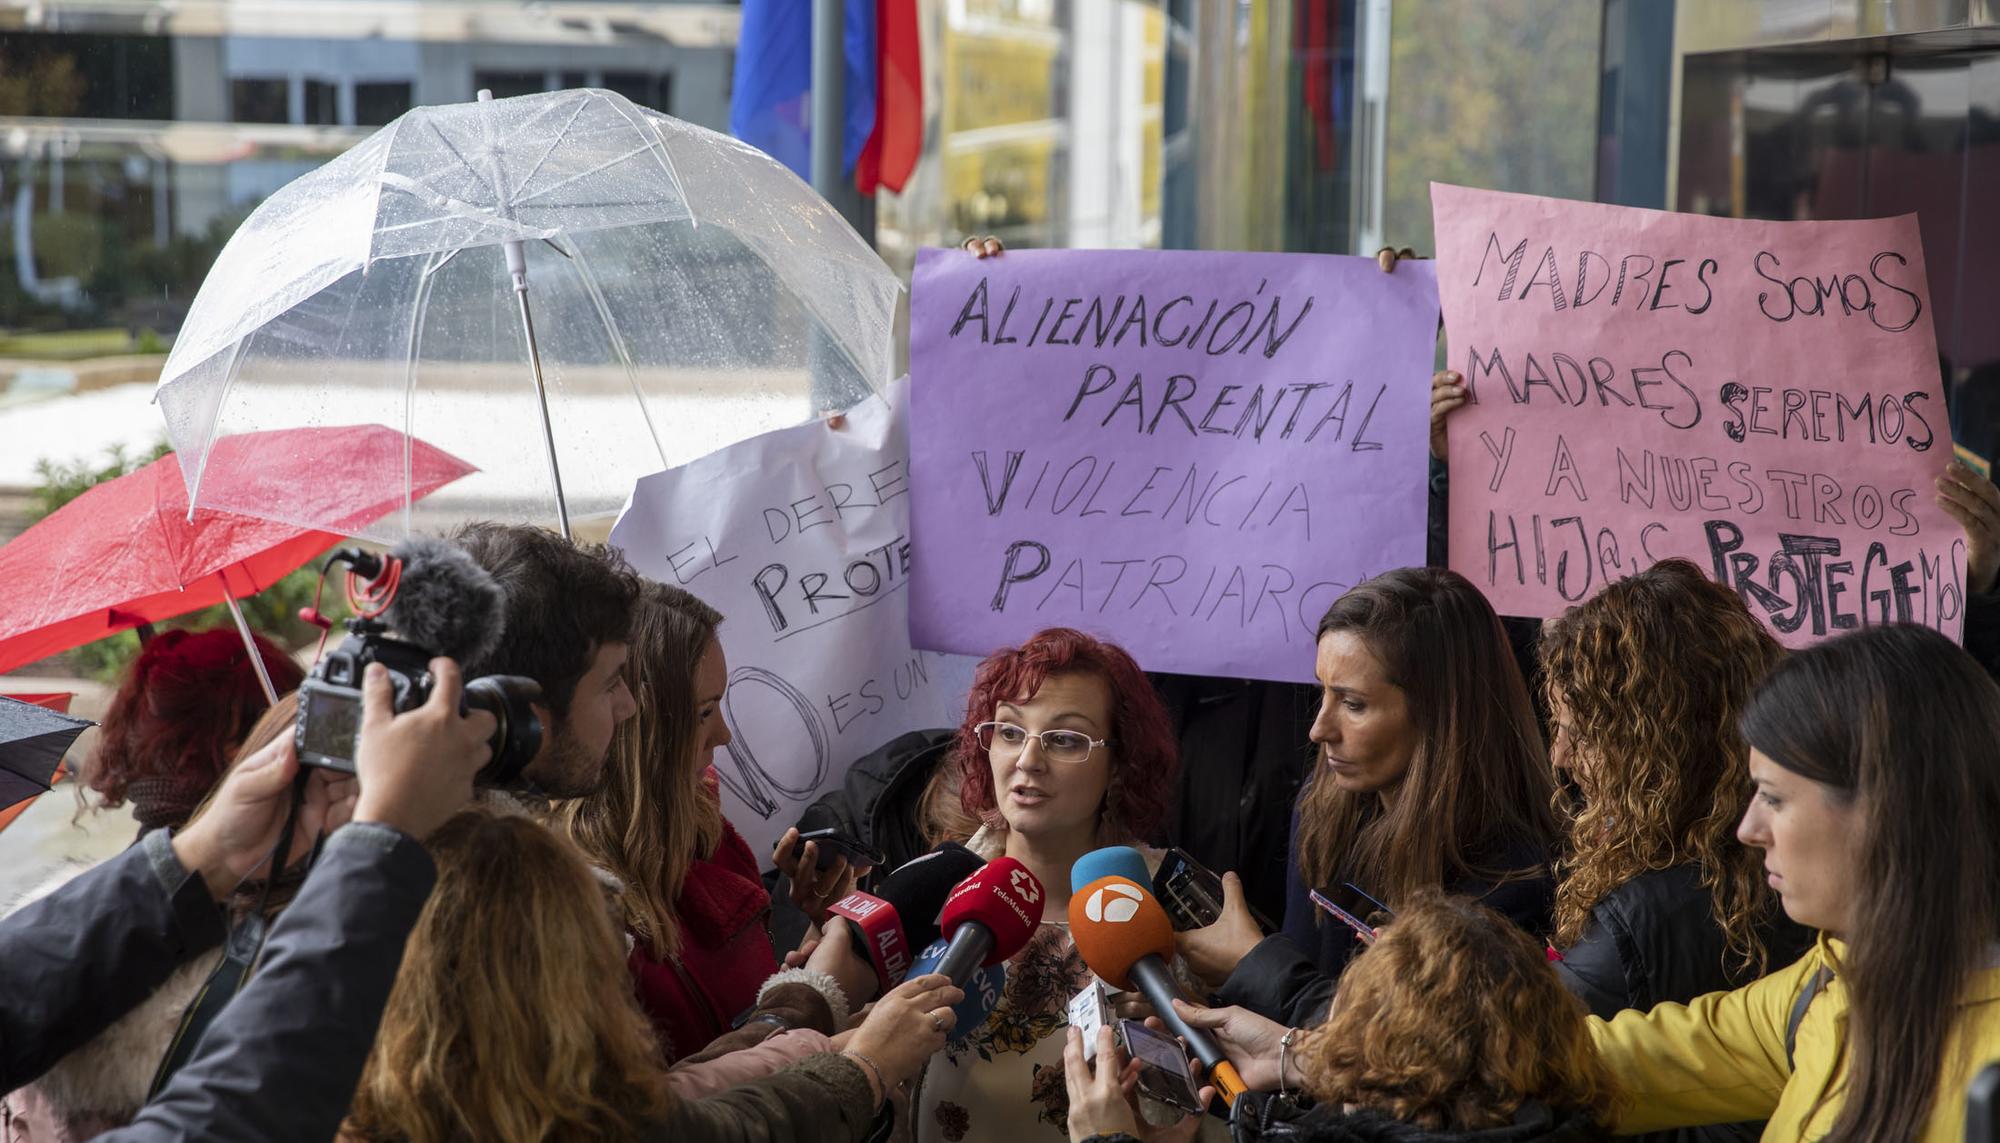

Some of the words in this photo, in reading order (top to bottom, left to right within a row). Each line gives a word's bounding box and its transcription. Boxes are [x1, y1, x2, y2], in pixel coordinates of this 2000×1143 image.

[949, 277, 1314, 359] ALIENACIÓN
[1473, 231, 1718, 315] MADRES
[1063, 364, 1387, 452] PARENTAL
[1467, 345, 1702, 430] MADRES
[1720, 381, 1934, 452] SEREMOS
[666, 536, 739, 586] EL
[763, 459, 911, 544] DERE
[971, 449, 1313, 542] VIOLENCIA
[1480, 426, 1517, 493] Y
[1545, 434, 1588, 501] A
[1616, 446, 1920, 537] NUESTROS
[990, 540, 1367, 642] PATRIARC
[828, 679, 884, 735] ES
[894, 650, 928, 700] UN
[992, 885, 1032, 928] TeleMadrid
